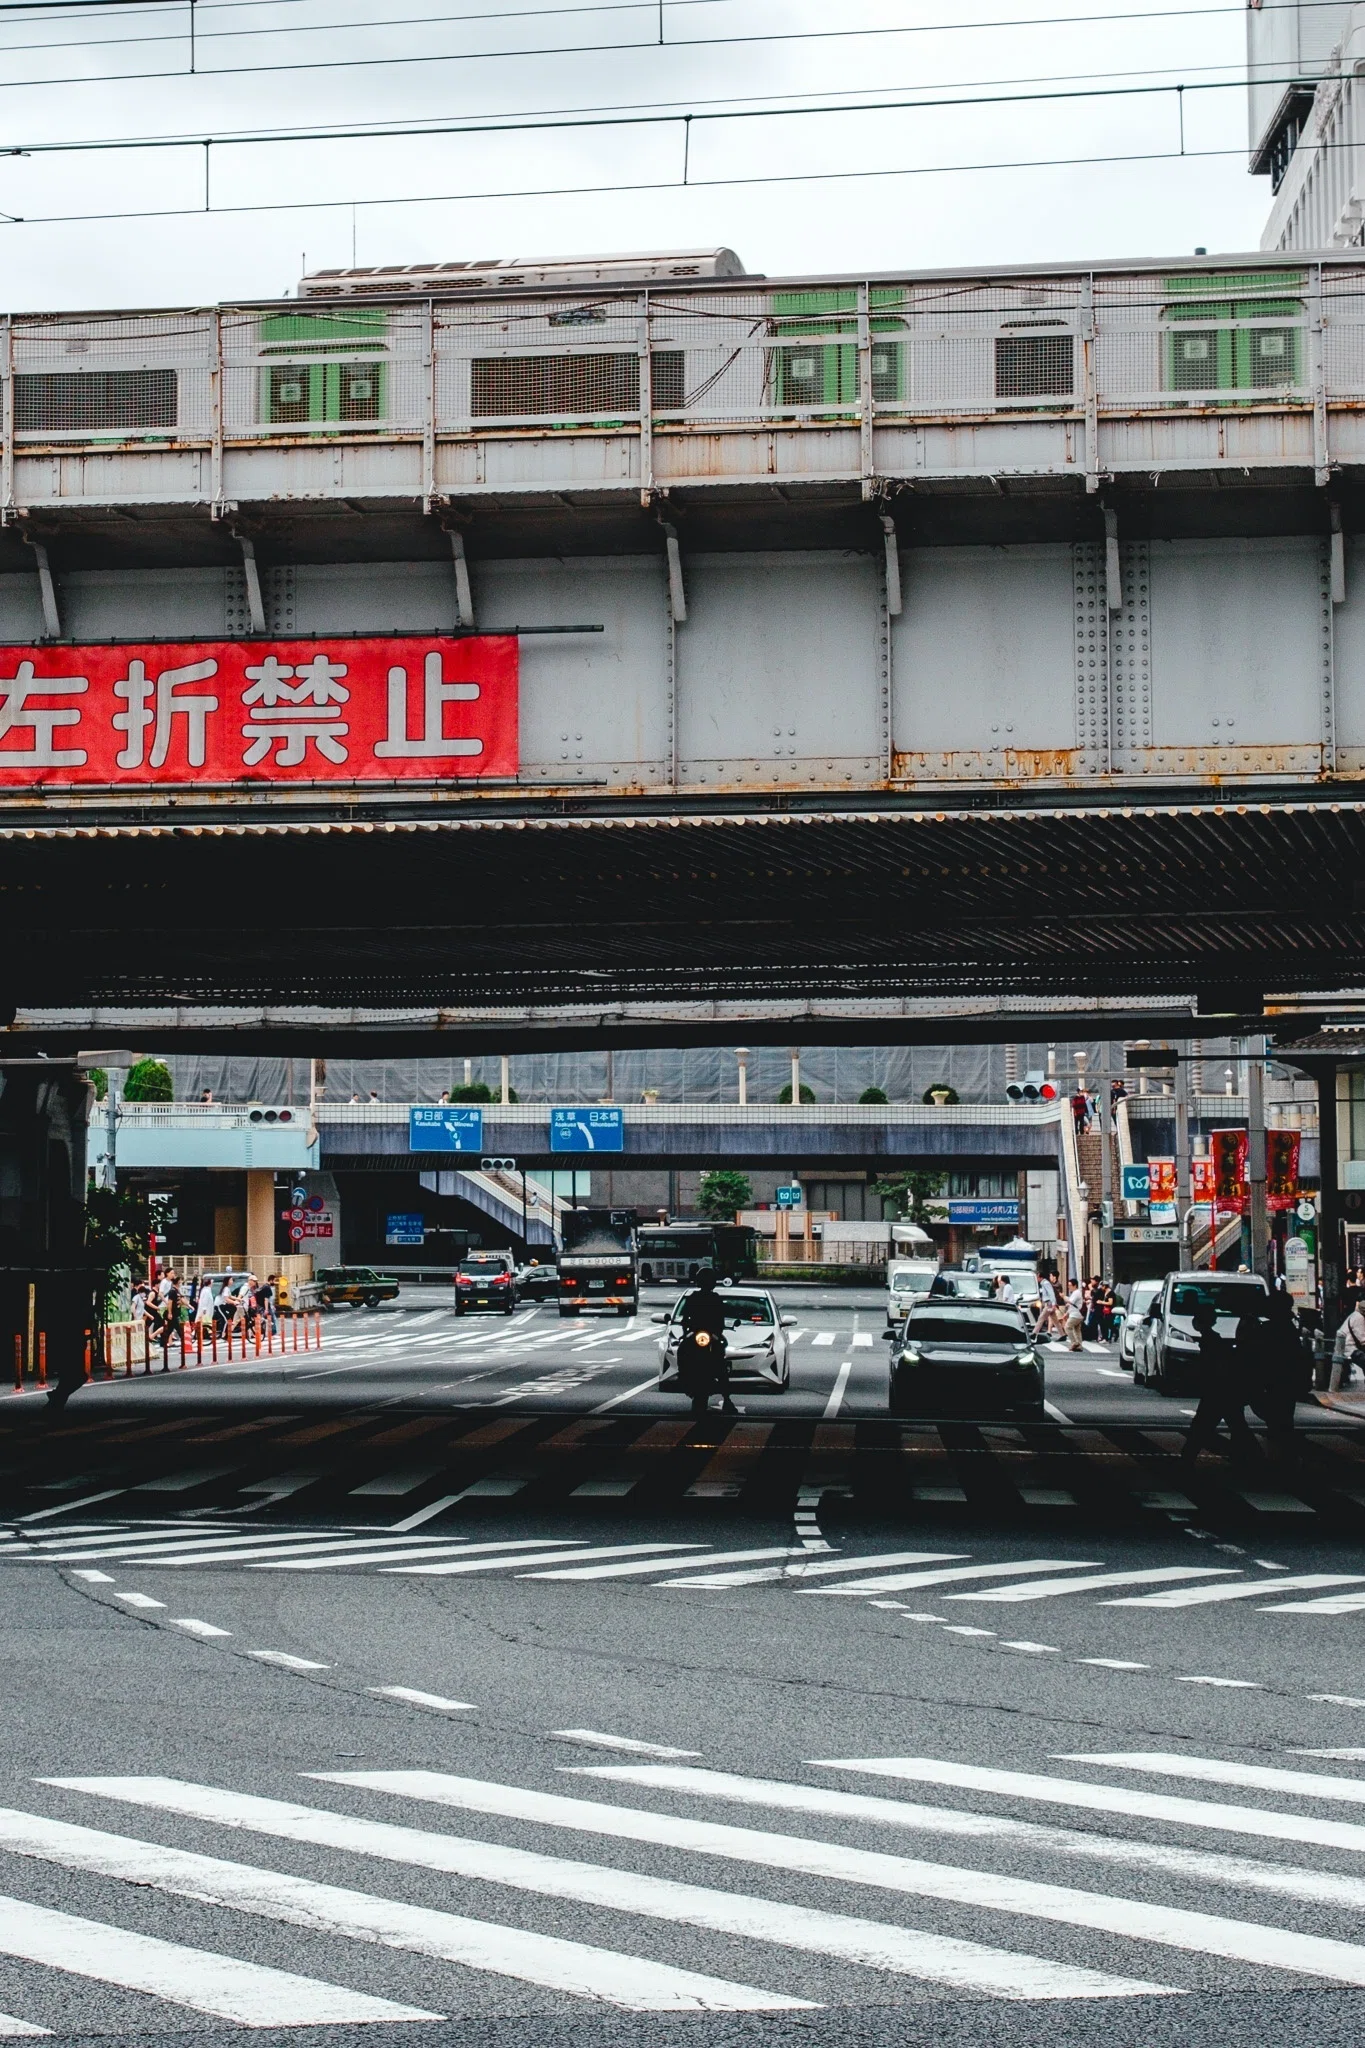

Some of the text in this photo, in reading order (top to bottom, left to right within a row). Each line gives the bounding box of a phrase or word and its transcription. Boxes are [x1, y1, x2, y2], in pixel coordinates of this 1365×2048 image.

[0, 651, 483, 769] 左折禁止
[414, 1111, 479, 1122] 春日部 三ノ輪
[555, 1111, 619, 1121] 浅草 日本橋
